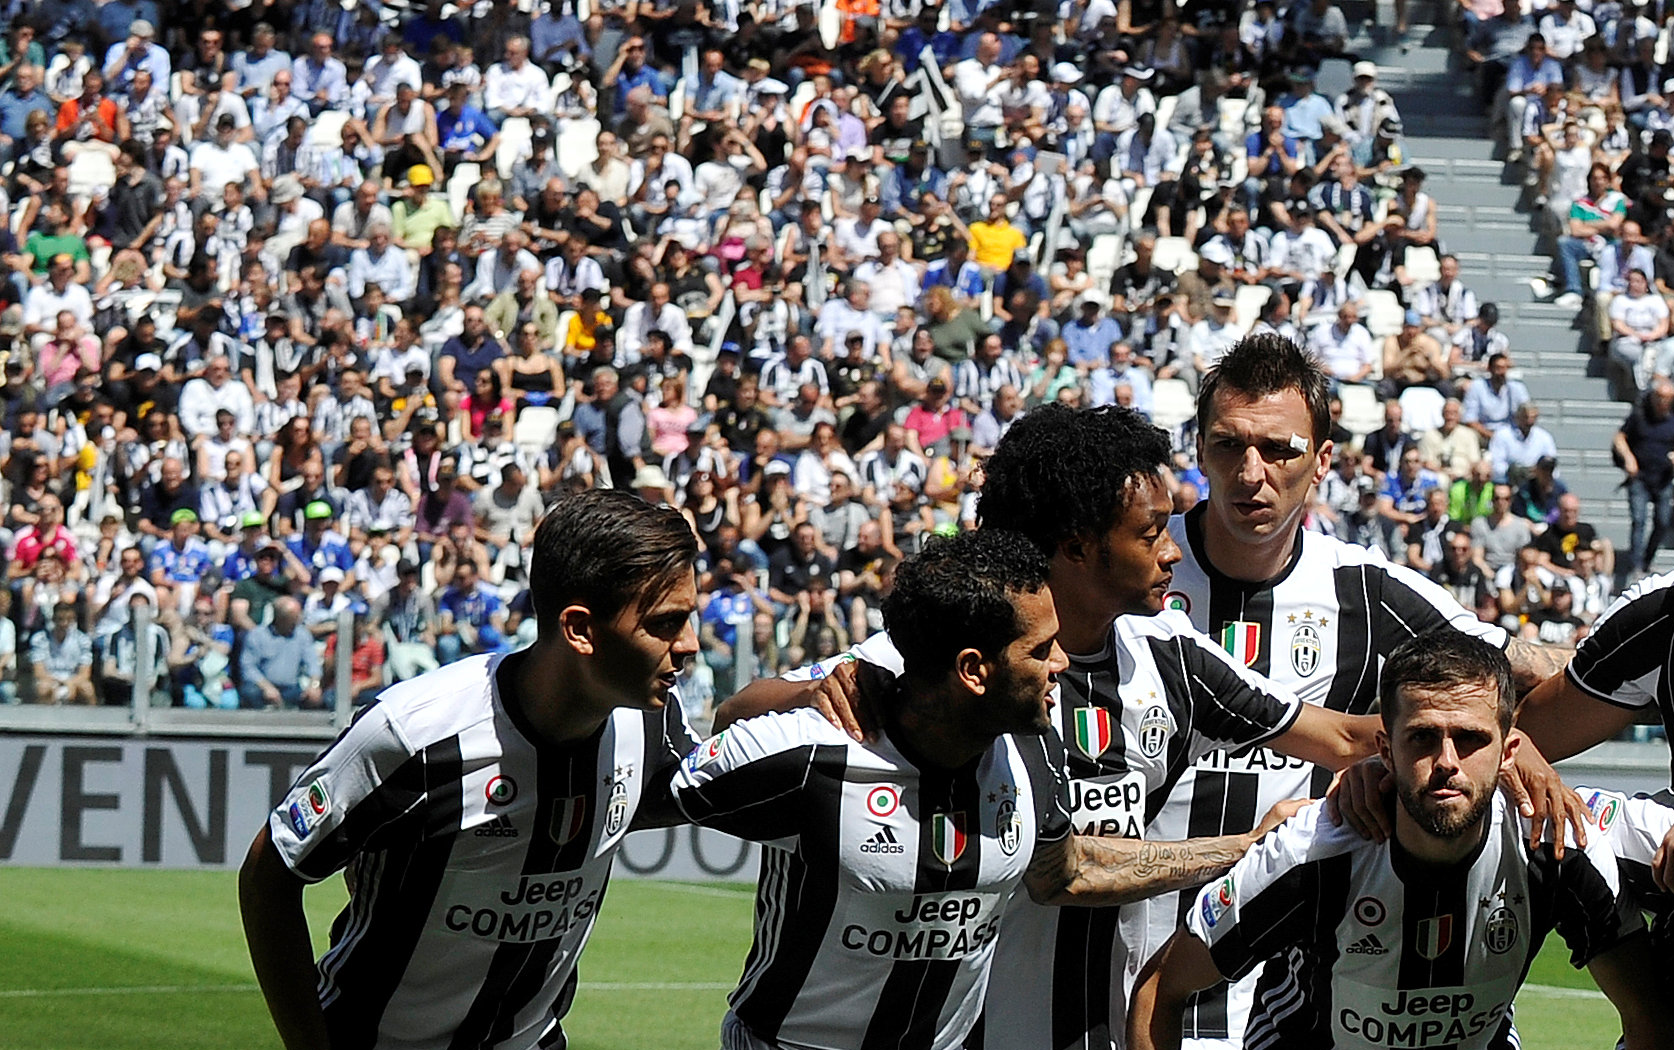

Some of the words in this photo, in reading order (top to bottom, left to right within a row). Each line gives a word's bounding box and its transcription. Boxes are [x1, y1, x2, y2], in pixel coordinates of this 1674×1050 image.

[1070, 781, 1141, 812] Jeep
[474, 826, 519, 838] adidas
[860, 842, 905, 854] adidas
[501, 876, 584, 906] Jeep
[894, 896, 982, 927] Jeep
[841, 914, 1000, 959] COMPASS
[1345, 945, 1390, 956] adidas
[1381, 991, 1475, 1018] Jeep
[1339, 1001, 1506, 1048] COMPASS
